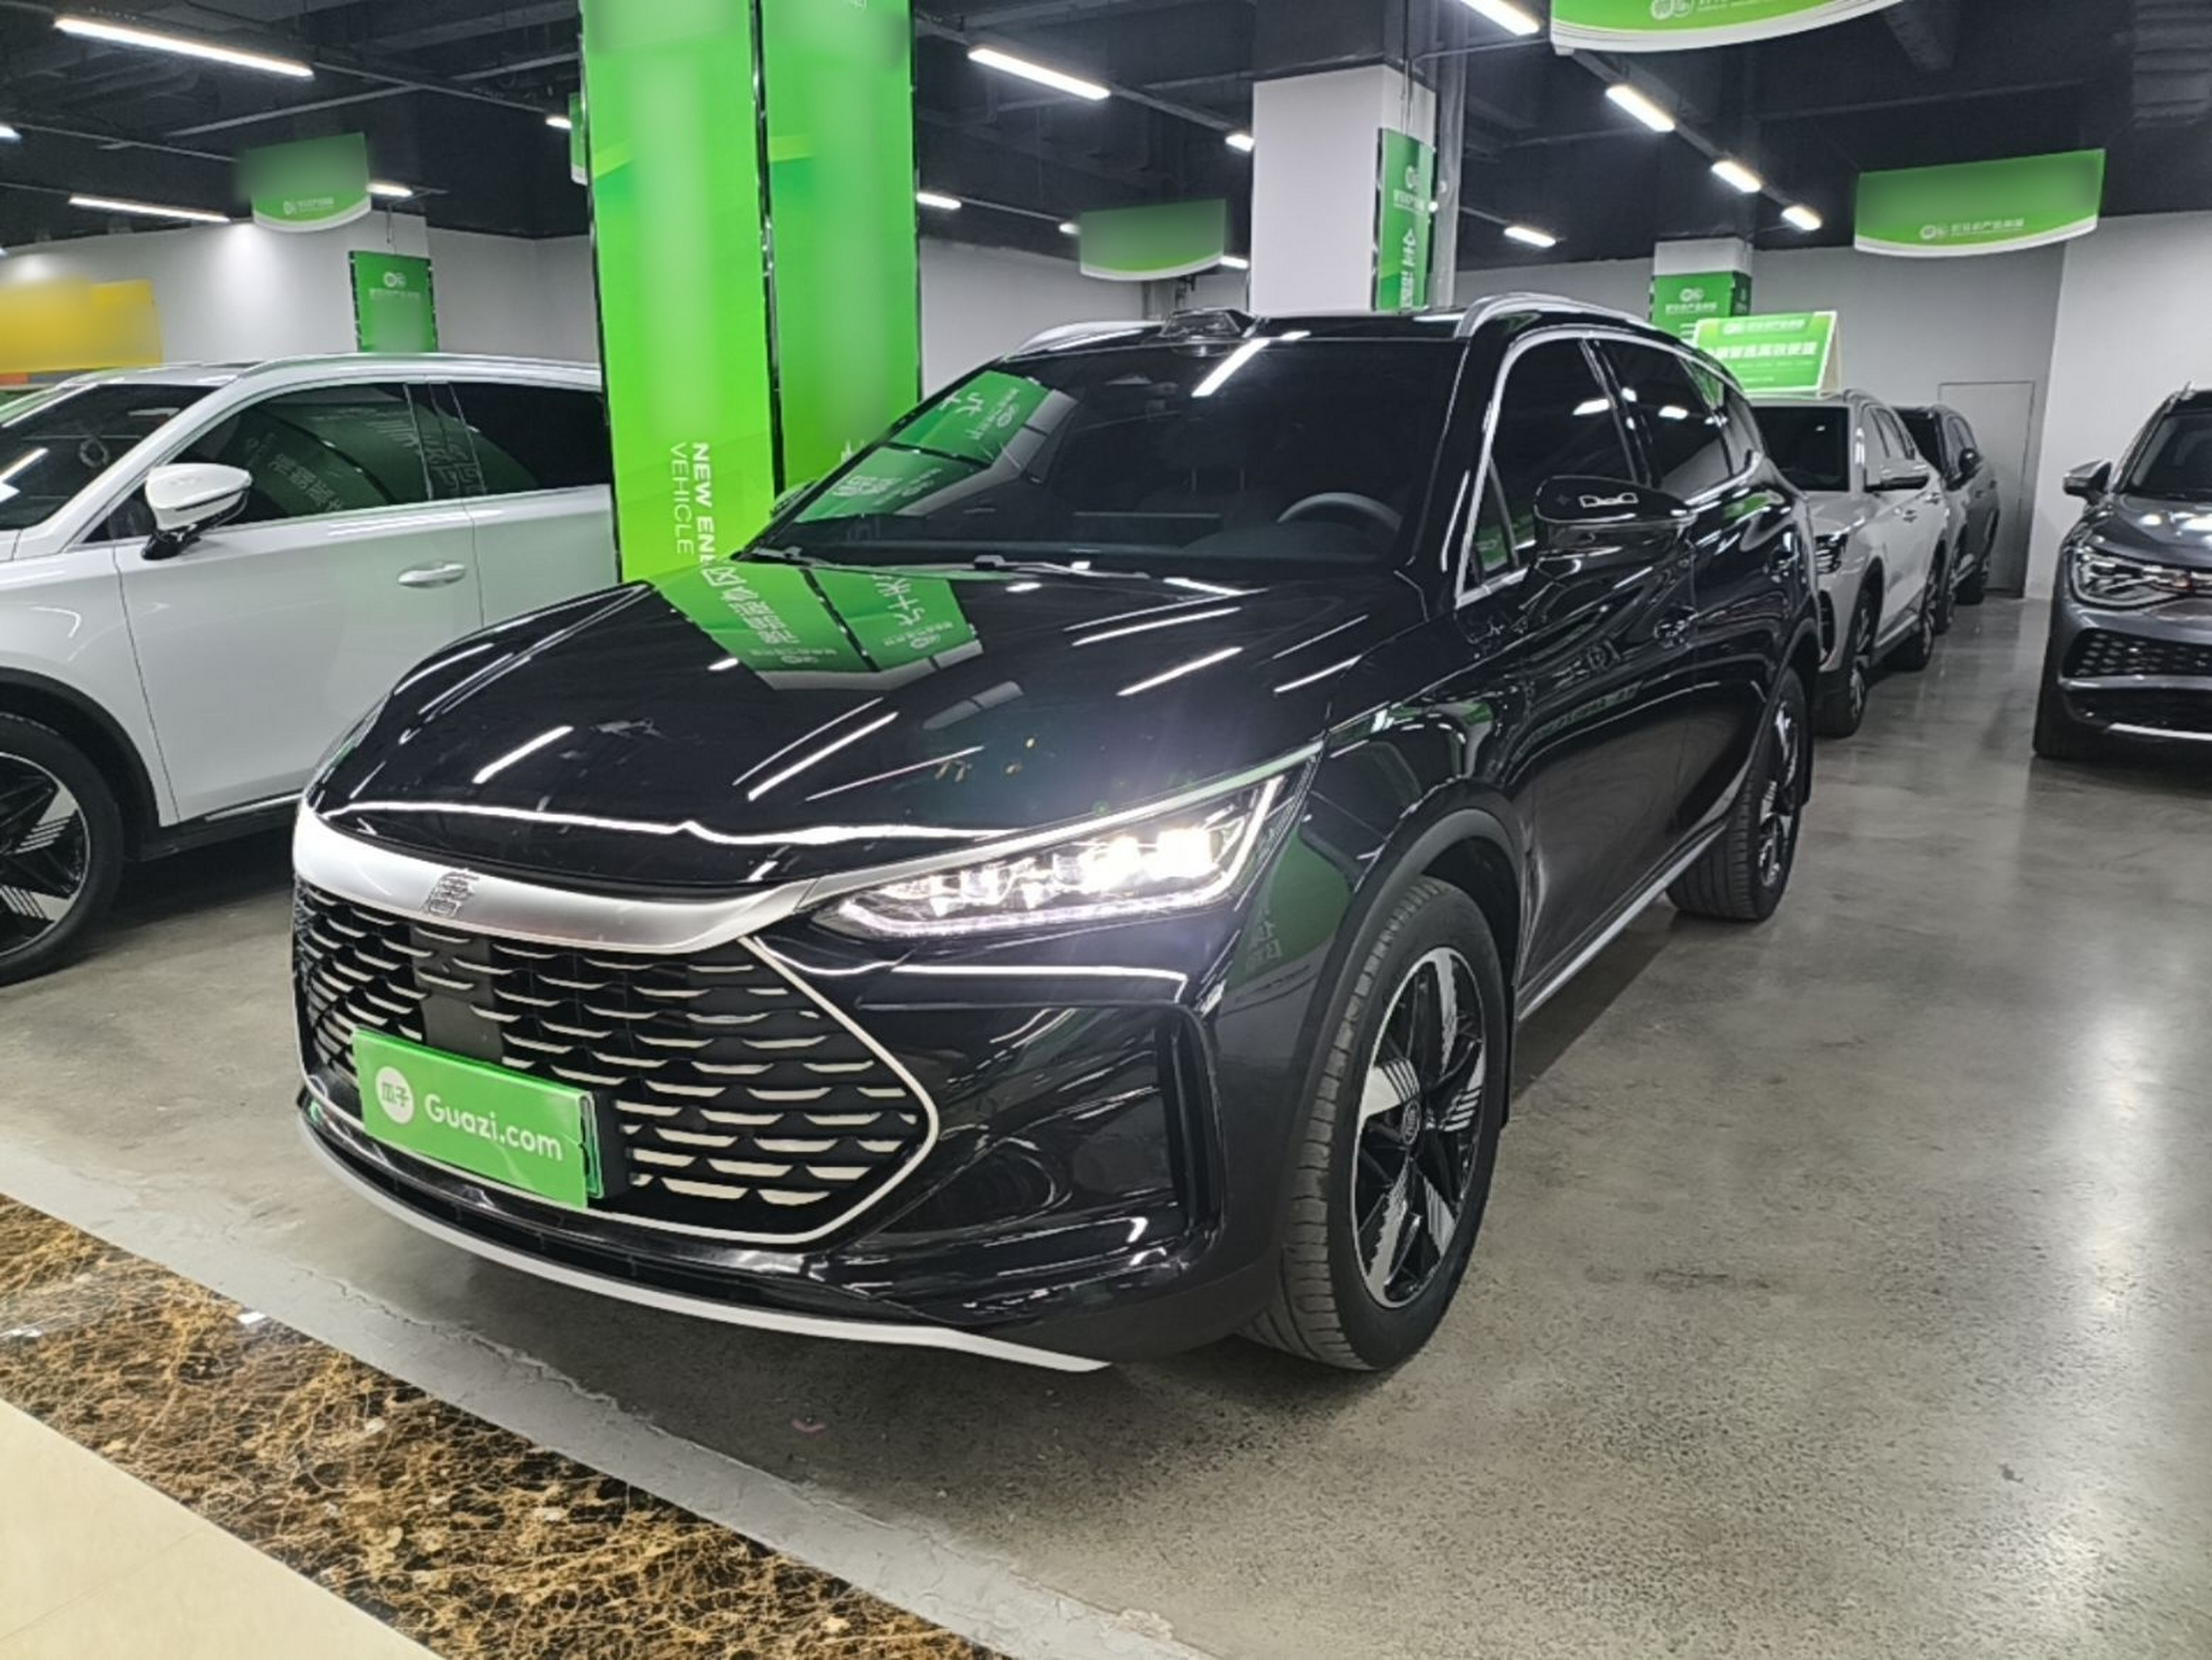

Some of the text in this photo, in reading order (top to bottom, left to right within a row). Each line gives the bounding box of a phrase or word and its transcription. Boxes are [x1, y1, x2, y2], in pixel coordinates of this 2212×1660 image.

[670, 441, 694, 556] VEHICLE
[692, 442, 713, 508] NEW
[381, 1082, 411, 1109] 瓜子
[424, 1093, 564, 1162] Guazi.com
